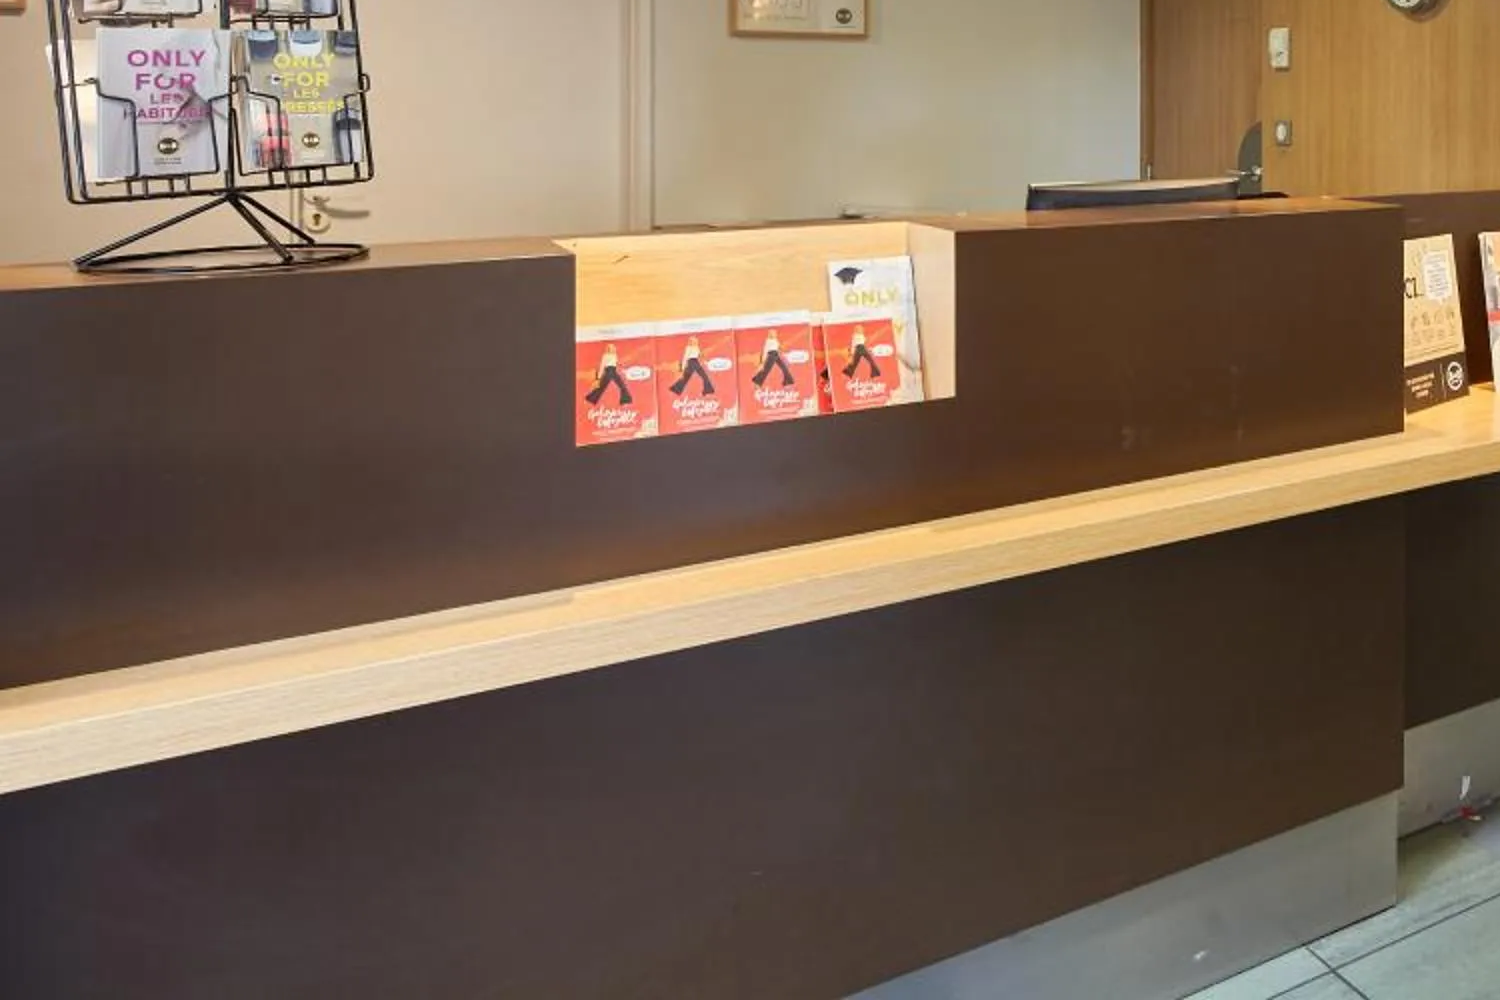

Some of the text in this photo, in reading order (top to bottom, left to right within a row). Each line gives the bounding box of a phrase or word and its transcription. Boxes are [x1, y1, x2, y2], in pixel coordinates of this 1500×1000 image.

[127, 49, 206, 67] ONLY
[273, 52, 335, 70] ONLY
[135, 72, 197, 91] FOR
[282, 71, 330, 88] FOR
[844, 287, 898, 307] ONLY
